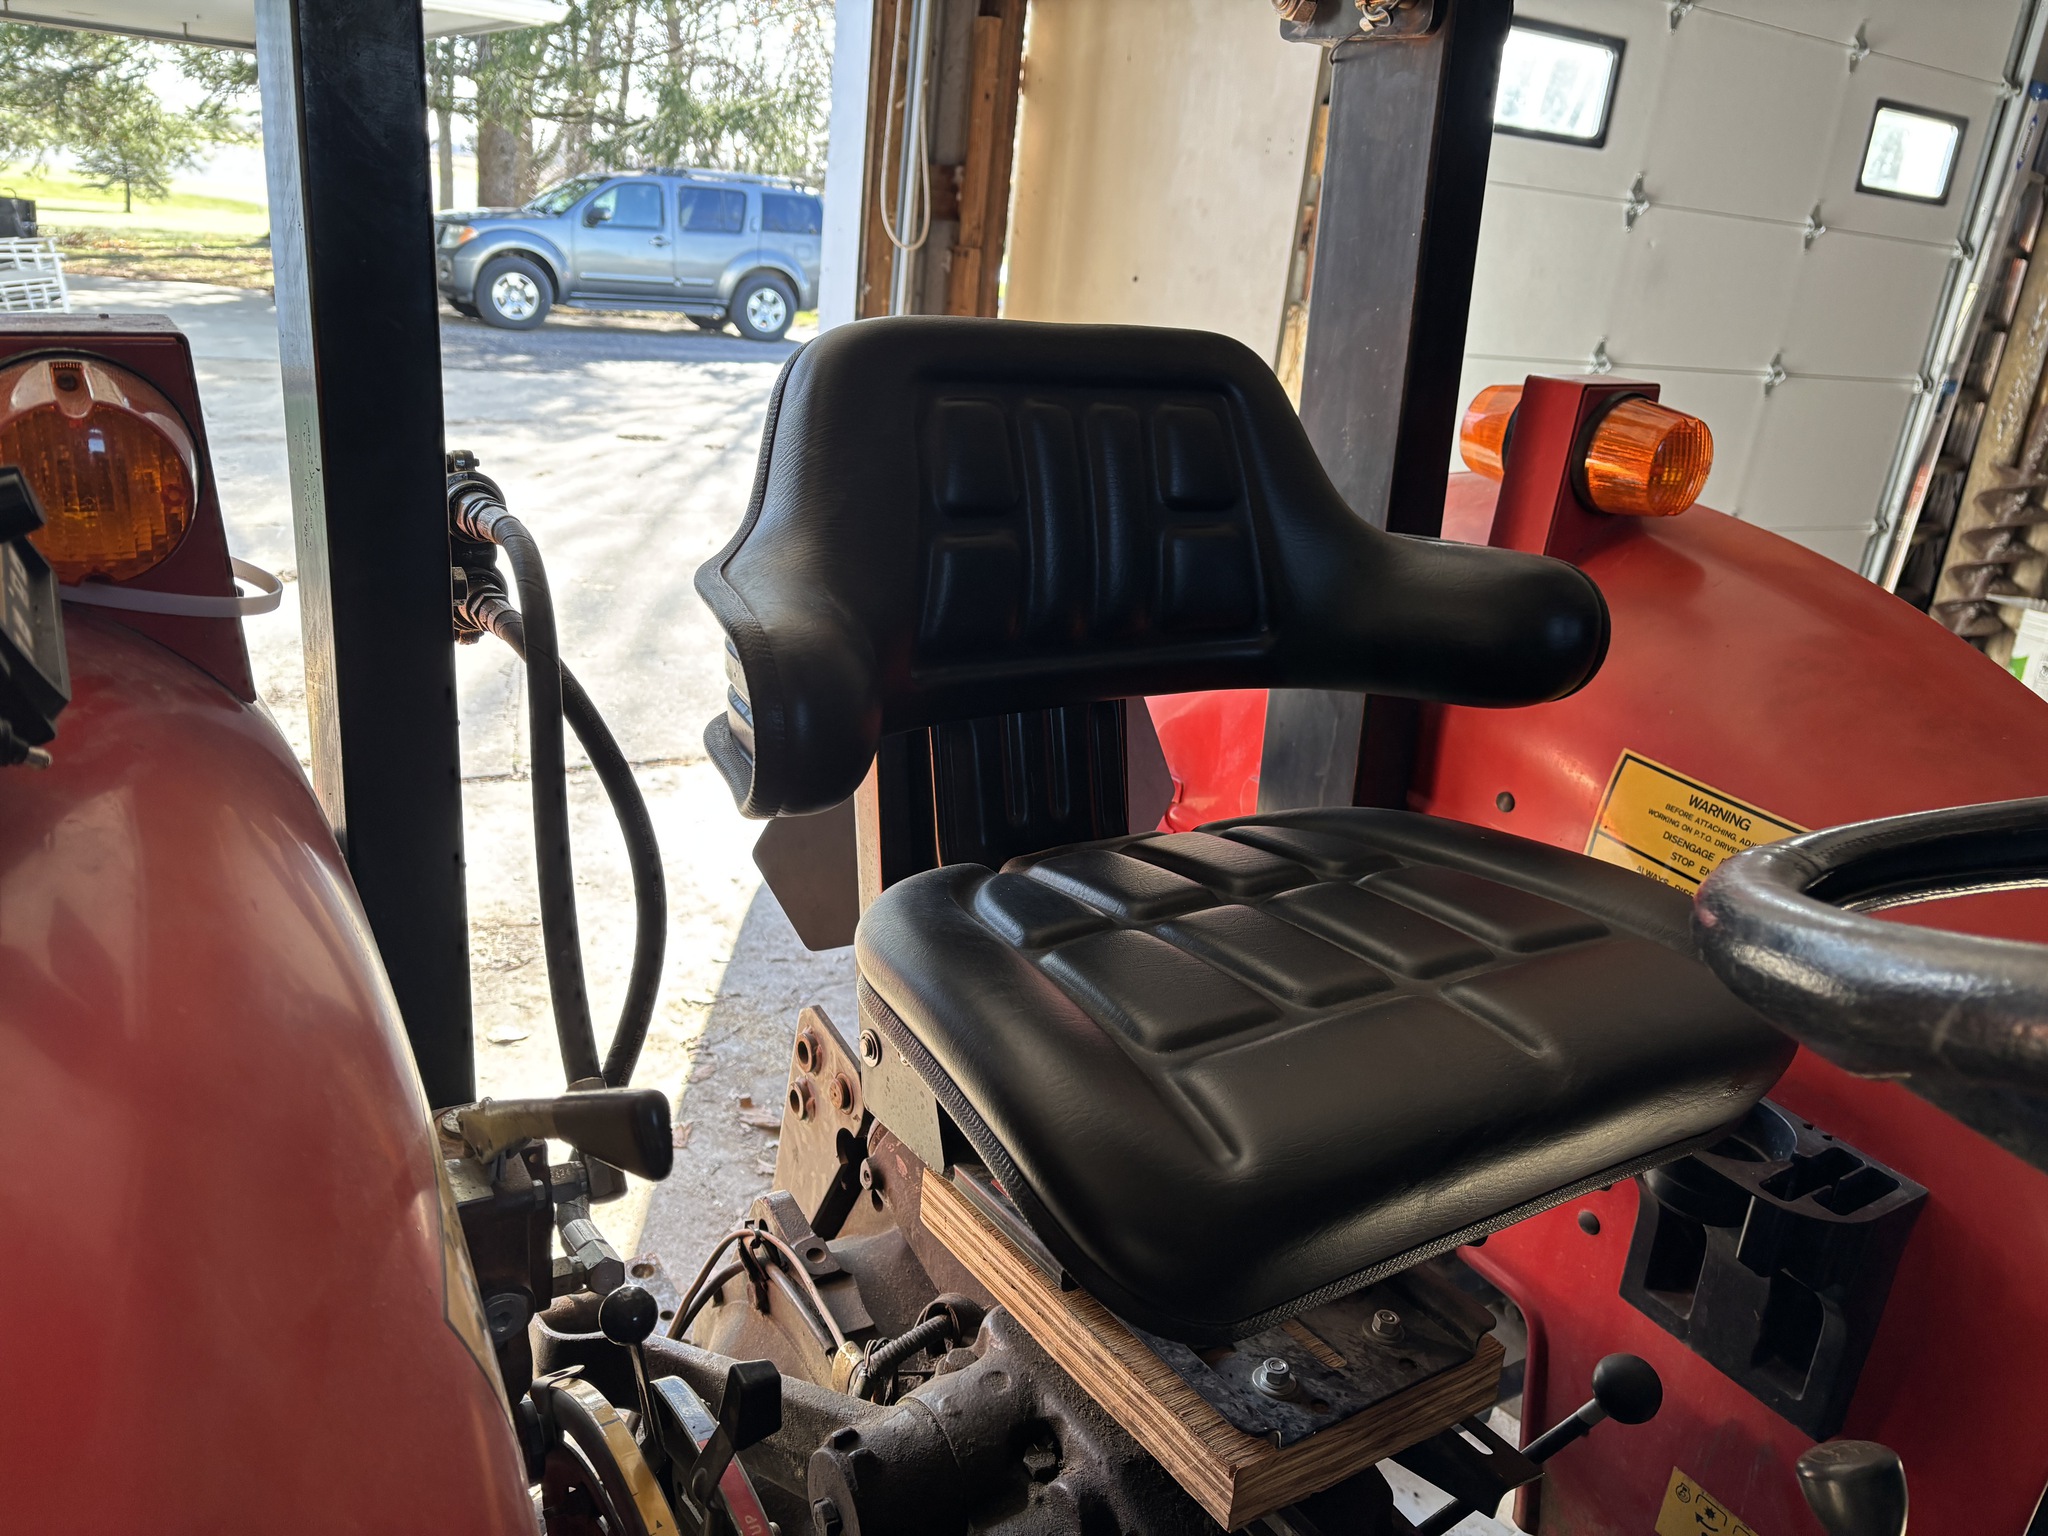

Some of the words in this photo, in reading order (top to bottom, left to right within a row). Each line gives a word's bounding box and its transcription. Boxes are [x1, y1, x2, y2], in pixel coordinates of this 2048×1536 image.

[1648, 808, 1680, 828] WORKING
[1681, 823, 1694, 834] ON
[1694, 829, 1713, 843] P.T.O.
[1665, 803, 1694, 821] BEFORE
[1695, 818, 1737, 842] ATTACHING,
[1739, 837, 1757, 848] ADJ
[1689, 794, 1752, 832] WARNING
[1662, 830, 1716, 862] DISENGAGE
[1670, 851, 1696, 868] STOP
[744, 1514, 762, 1536] UP
